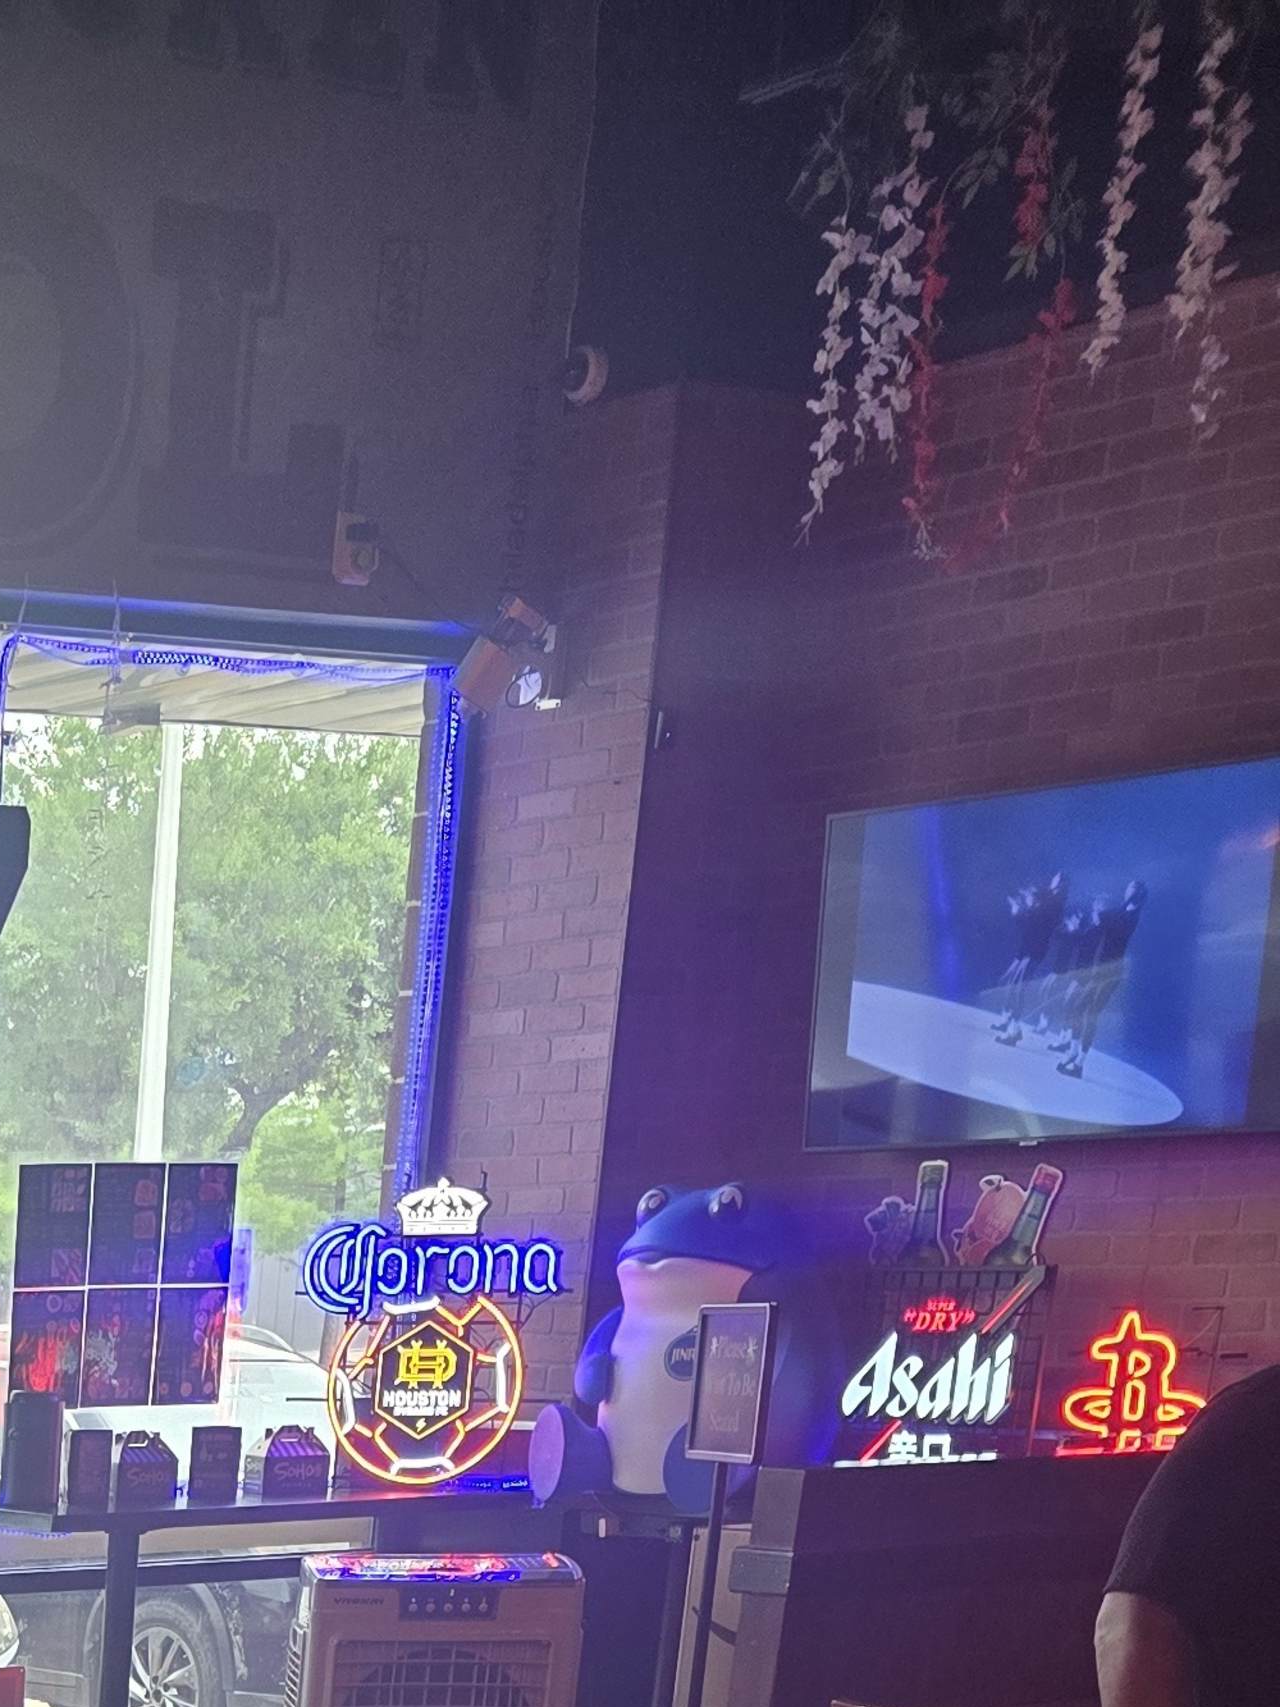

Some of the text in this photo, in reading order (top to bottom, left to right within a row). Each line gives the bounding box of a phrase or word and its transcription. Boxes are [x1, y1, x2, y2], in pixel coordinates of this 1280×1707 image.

[303, 1223, 558, 1321] Corona
[672, 1347, 696, 1364] JINR
[841, 1329, 1015, 1422] Asahi
[382, 1389, 462, 1408] HOUSTON
